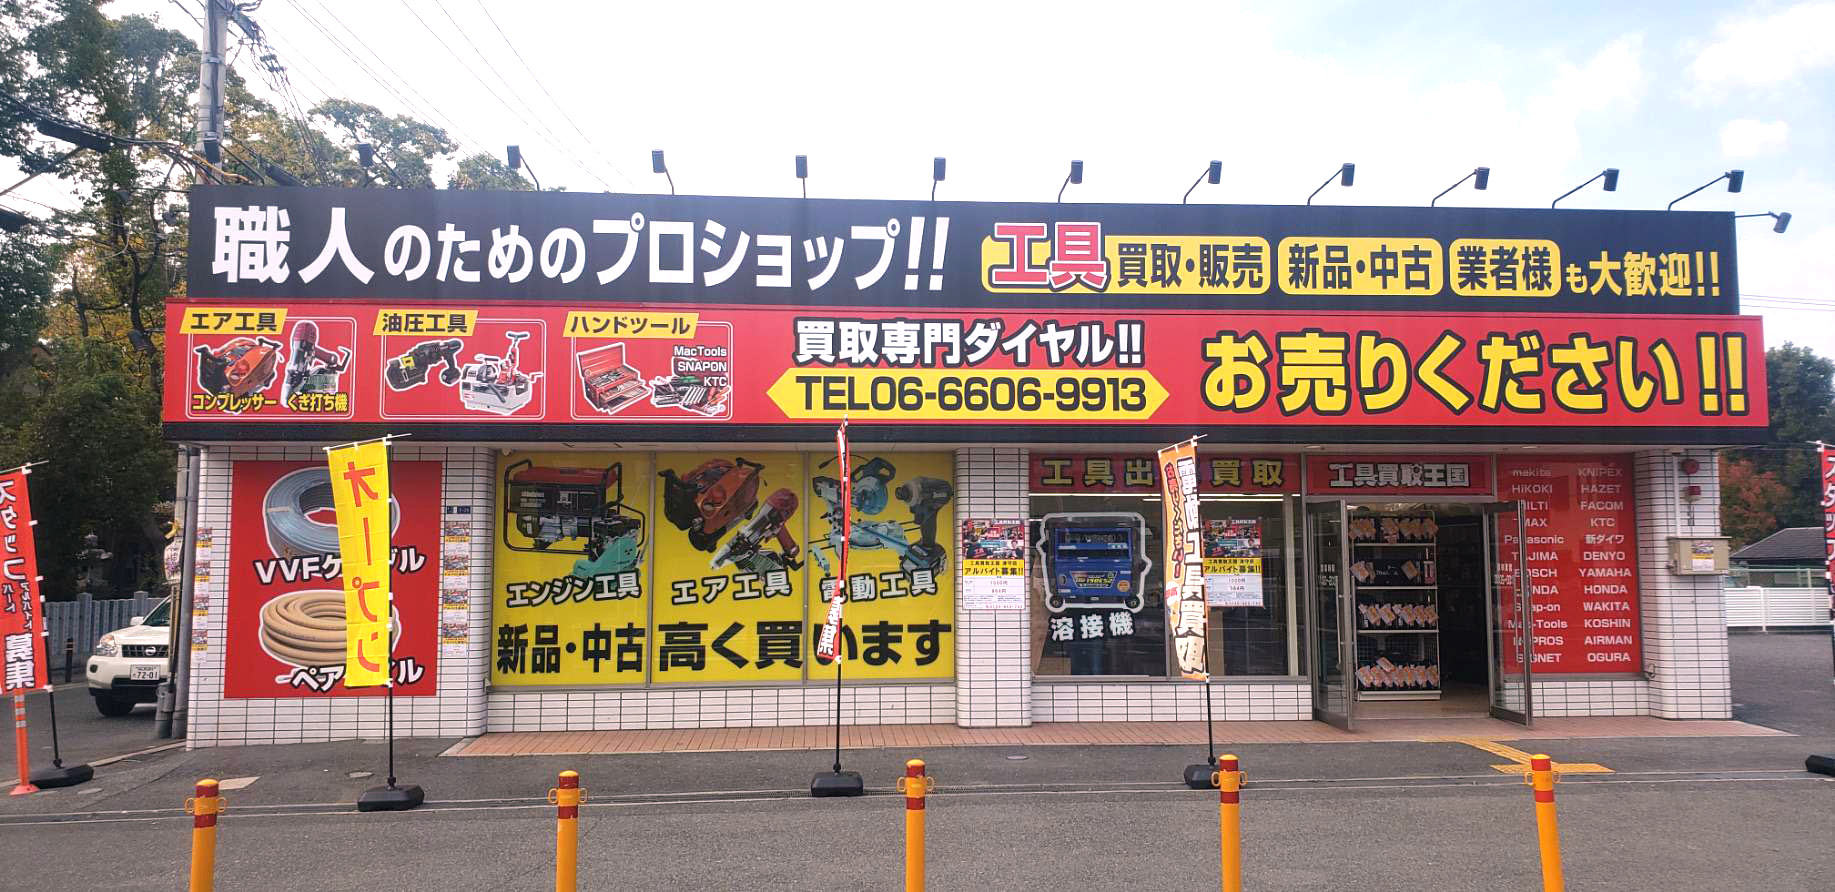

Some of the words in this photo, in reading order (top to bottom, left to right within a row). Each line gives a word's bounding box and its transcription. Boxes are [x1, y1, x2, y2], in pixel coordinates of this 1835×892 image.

[212, 205, 950, 290] 職人のためのプロショップ!!
[1288, 244, 1431, 290] 新品・中古
[1457, 245, 1552, 291] 業者様
[191, 313, 277, 331] エア工具
[382, 313, 467, 332] 油圧工具
[571, 316, 691, 335] ハンドツール
[797, 322, 1142, 365] 買取専門ダイヤル!!
[674, 346, 728, 357] MacTools
[677, 361, 728, 372] SNAPON
[703, 376, 728, 387] KTC
[796, 376, 1147, 412] TEL06-6606-9913
[192, 394, 277, 411] コンプレッサー
[288, 393, 348, 412] くぎ打ち機
[1042, 460, 1282, 487] 工具出買取
[1578, 468, 1623, 478] KNIPEX
[1581, 484, 1622, 494] HAZET
[1581, 501, 1624, 511] FACOM
[1591, 517, 1615, 527] KTC
[1504, 534, 1565, 544] Paasonic
[1586, 534, 1624, 545] 新ダイワ
[1512, 551, 1559, 561] TJIMA
[1584, 551, 1626, 561] DENYO
[255, 548, 424, 583] VVFケル
[1579, 568, 1632, 577] YAMAHA
[507, 573, 641, 605] エンジン工具
[673, 570, 791, 602] エア工具
[1584, 585, 1628, 594] HONDA
[1516, 602, 1561, 613] Sap-on
[1583, 602, 1630, 611] WAKITA
[1050, 612, 1135, 642] 溶接機
[1584, 619, 1631, 628] KOSHIN
[1584, 636, 1632, 645] AIRMAN
[497, 622, 645, 674] 新品・中古
[1517, 653, 1562, 663] SGNET
[1587, 653, 1631, 662] OGURA
[291, 658, 423, 691] ペアル
